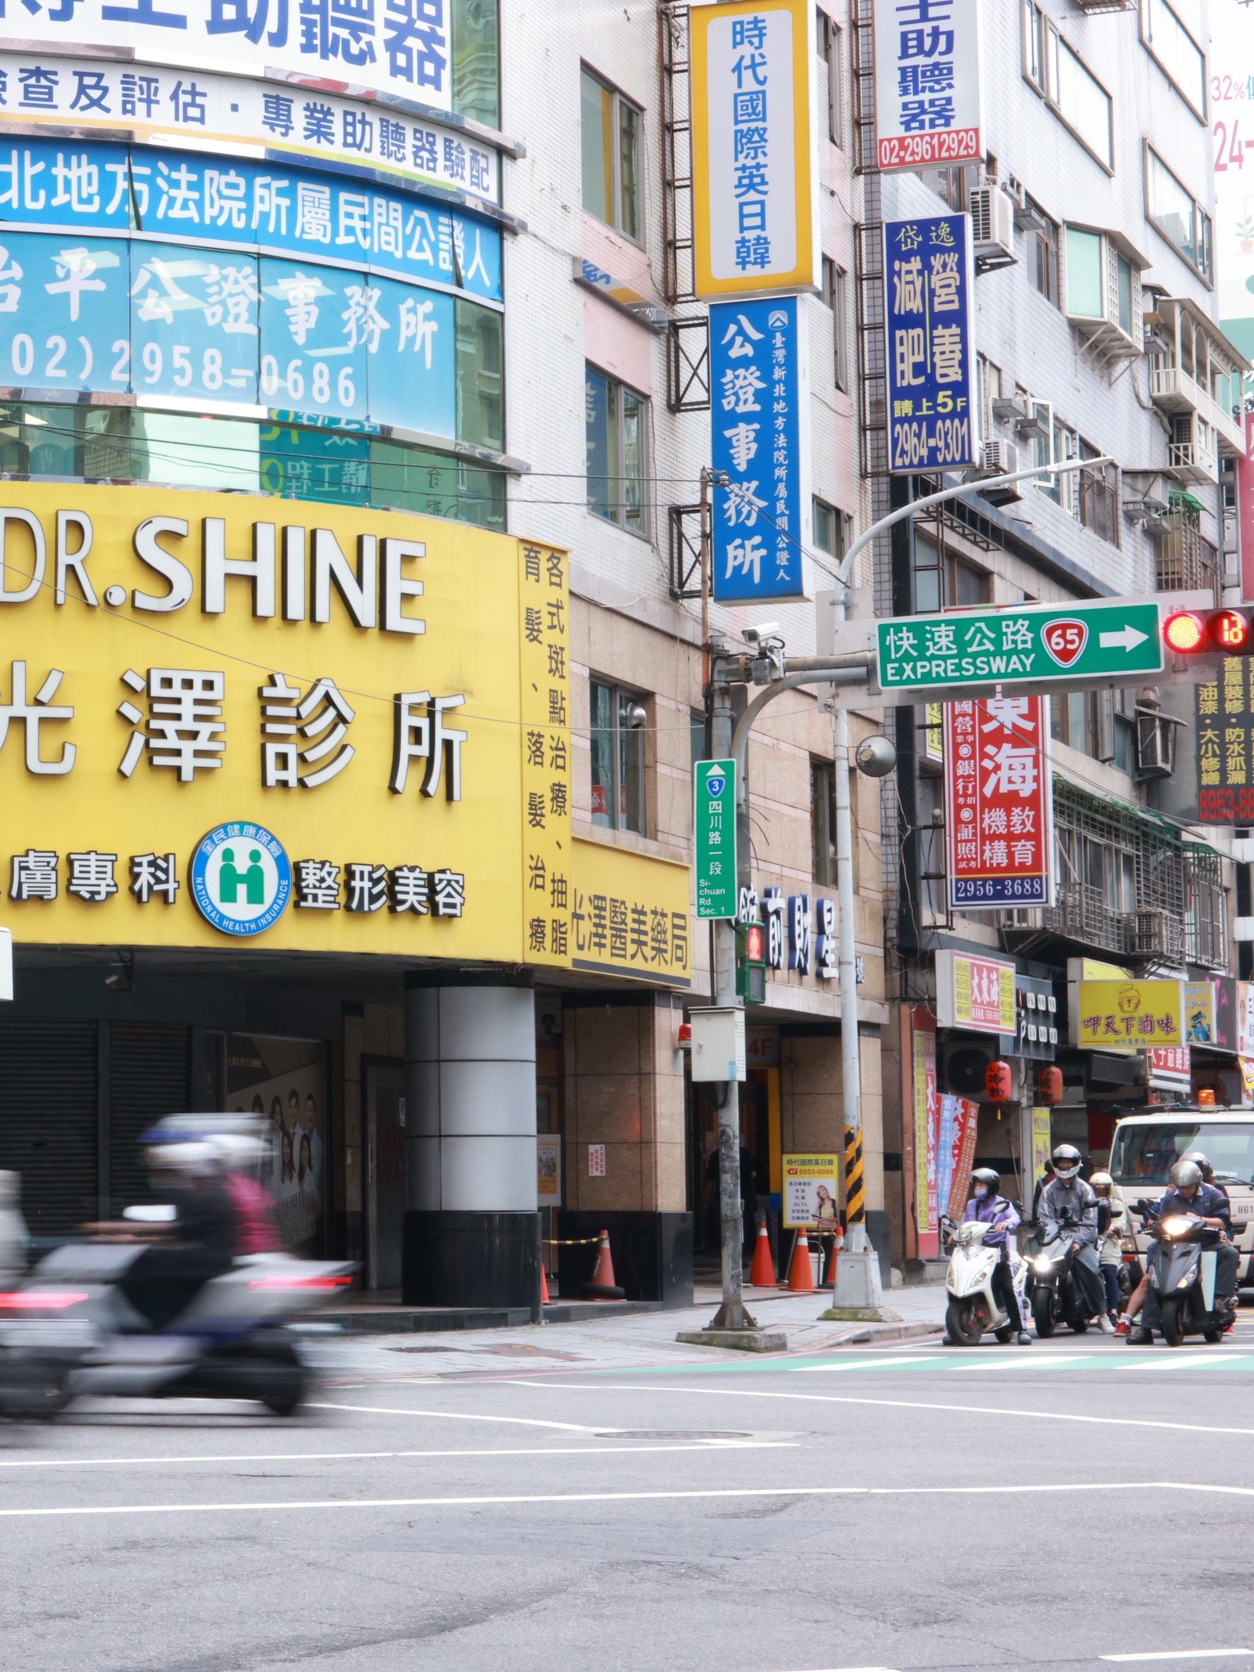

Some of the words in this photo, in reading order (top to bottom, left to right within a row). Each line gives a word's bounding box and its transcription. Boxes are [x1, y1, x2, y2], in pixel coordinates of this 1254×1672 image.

[261, 93, 491, 194] 專業助聽器驗配
[731, 16, 772, 271] 時代國際英日韓
[880, 130, 977, 166] 02-29612929
[893, 255, 925, 387] 減肥
[930, 251, 963, 384] 營養
[893, 391, 967, 418] 請上5F
[720, 314, 769, 585] 公證事務所
[772, 332, 791, 582] 臺灣新北地方法院所屬民間公證人
[894, 418, 969, 467] 2964-9301
[885, 618, 1035, 660] 快速公路
[886, 653, 1037, 682] EXPRESSWAY
[1050, 628, 1080, 651] 65
[523, 547, 547, 953] 育髮、落髮治療
[546, 553, 568, 957] 各式斑點治療、抽脂
[980, 695, 1039, 800] 東海
[712, 780, 720, 792] 3
[708, 801, 723, 875] 四川路一段
[982, 806, 1009, 868] 機構
[1009, 805, 1037, 867] 教育
[195, 877, 220, 923] NATIONAL
[222, 919, 257, 932] HEALTH
[258, 879, 289, 928] INSURANCE
[294, 858, 466, 919] 整形美容
[699, 887, 726, 896] chuan
[699, 898, 714, 906] Rd.
[699, 907, 718, 915] Sec.
[720, 906, 725, 914] 1
[957, 879, 1042, 898] 2956-3688
[571, 887, 688, 971] 光澤醫美藥局
[786, 1158, 834, 1167] 時代國際英日韓
